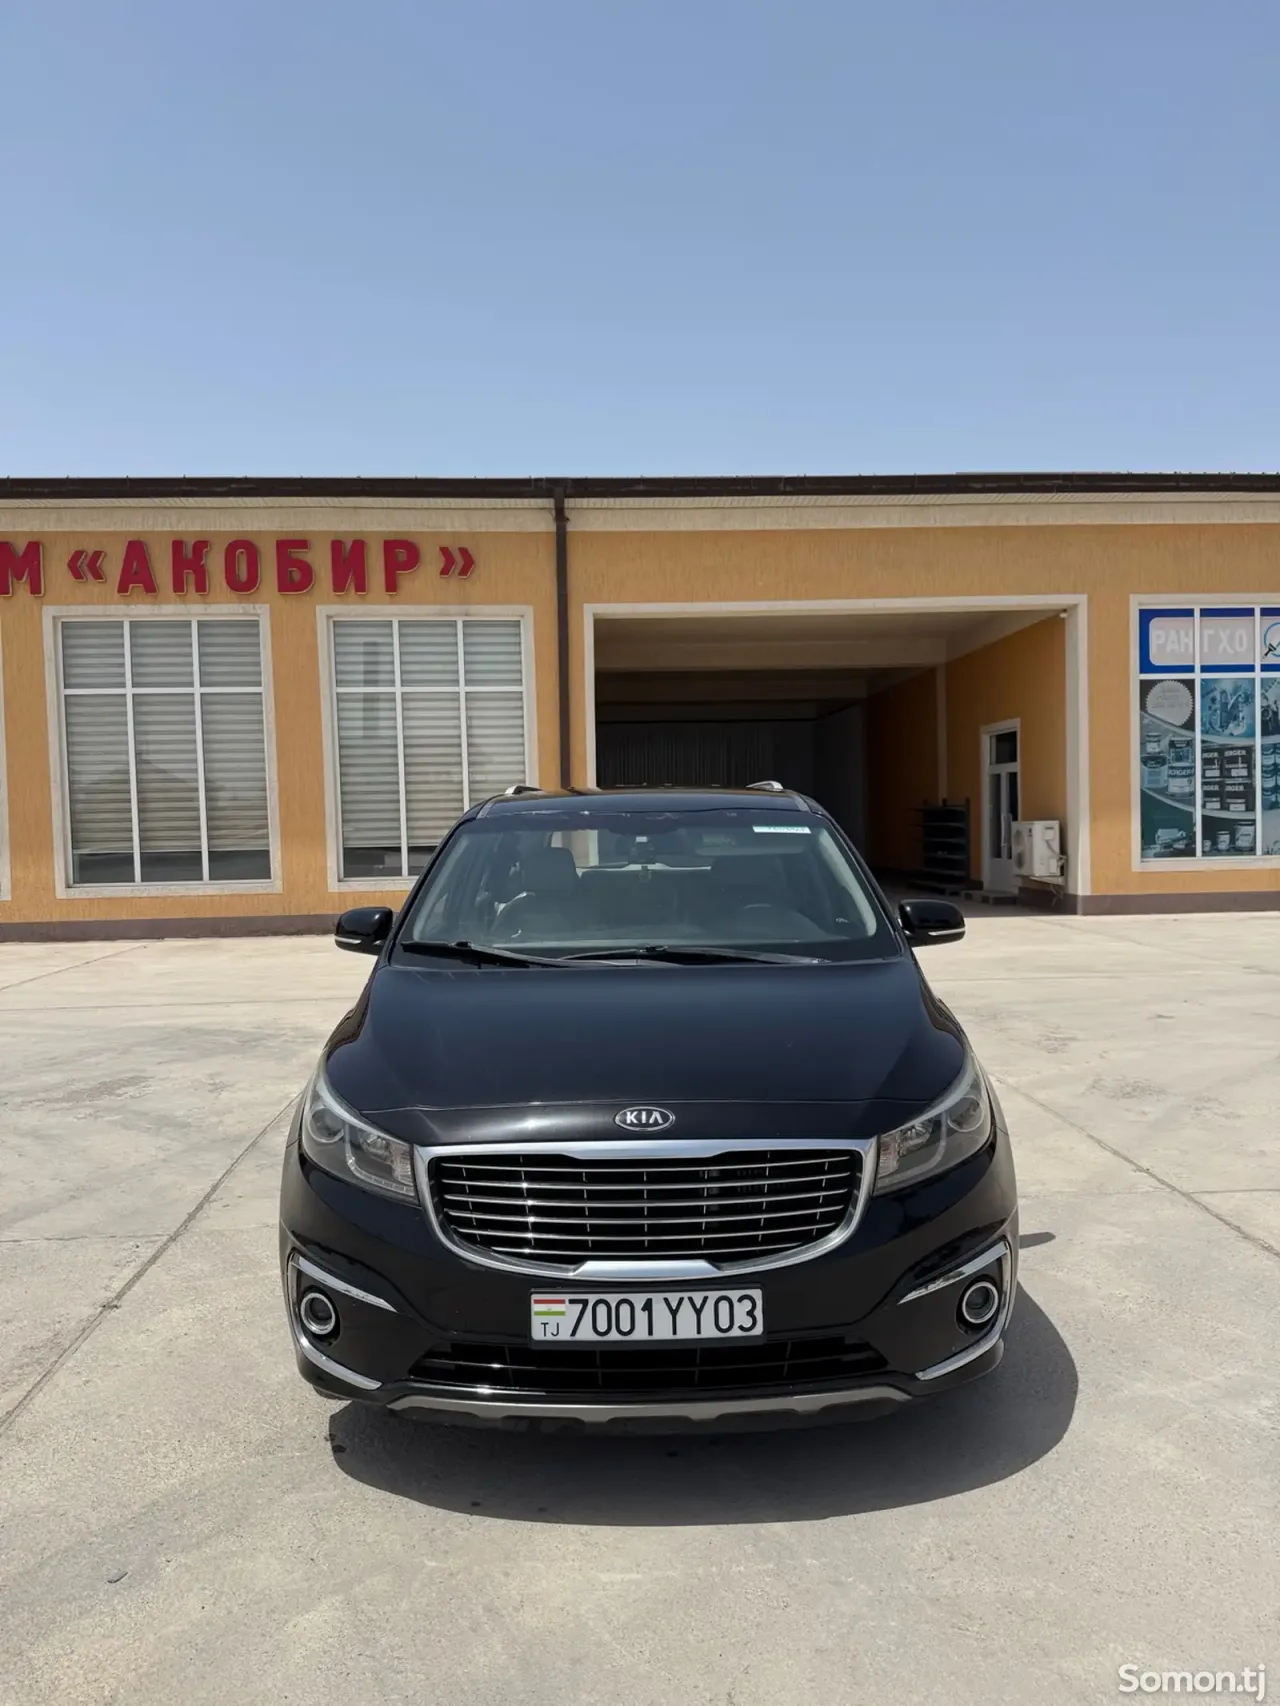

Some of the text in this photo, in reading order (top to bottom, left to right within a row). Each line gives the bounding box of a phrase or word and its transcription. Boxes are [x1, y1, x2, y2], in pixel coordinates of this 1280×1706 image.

[67, 539, 475, 596] «АКОБИР»
[626, 1111, 664, 1124] KIA
[541, 1322, 559, 1337] TJ
[568, 1294, 757, 1337] 7001YY03
